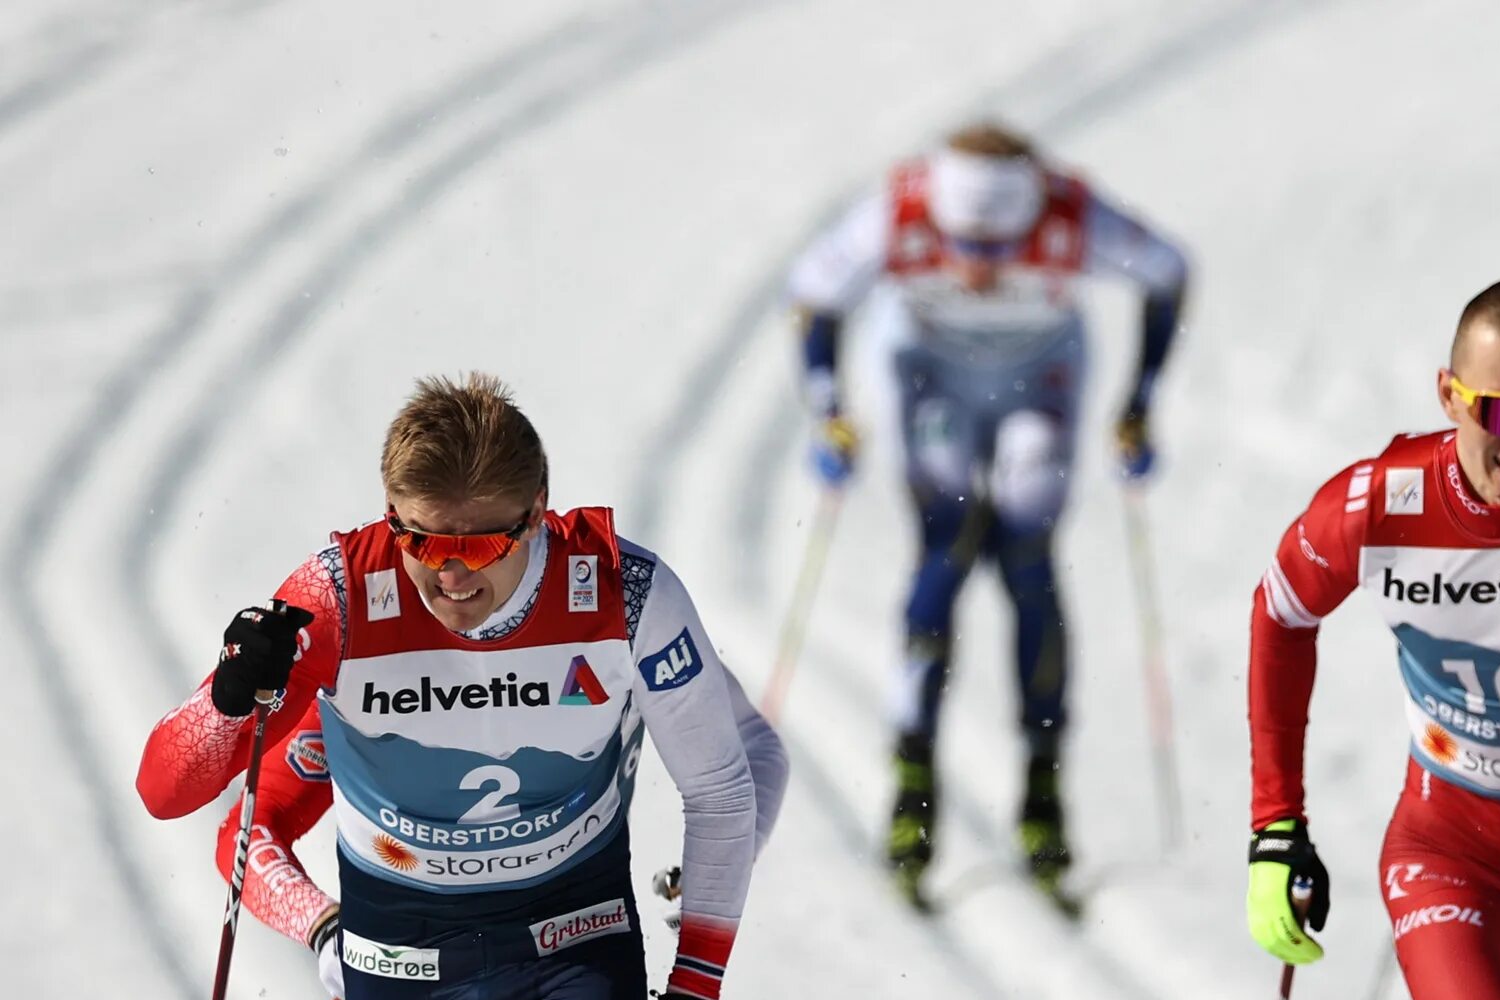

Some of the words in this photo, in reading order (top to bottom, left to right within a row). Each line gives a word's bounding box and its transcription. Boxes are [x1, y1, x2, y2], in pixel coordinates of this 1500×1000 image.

[362, 672, 550, 714] helvetia
[459, 765, 521, 825] 2
[380, 806, 564, 846] OBERSTDORF
[539, 904, 625, 950] Grilstad
[1394, 904, 1484, 939] LUKOIL
[345, 946, 436, 978] widerøe
